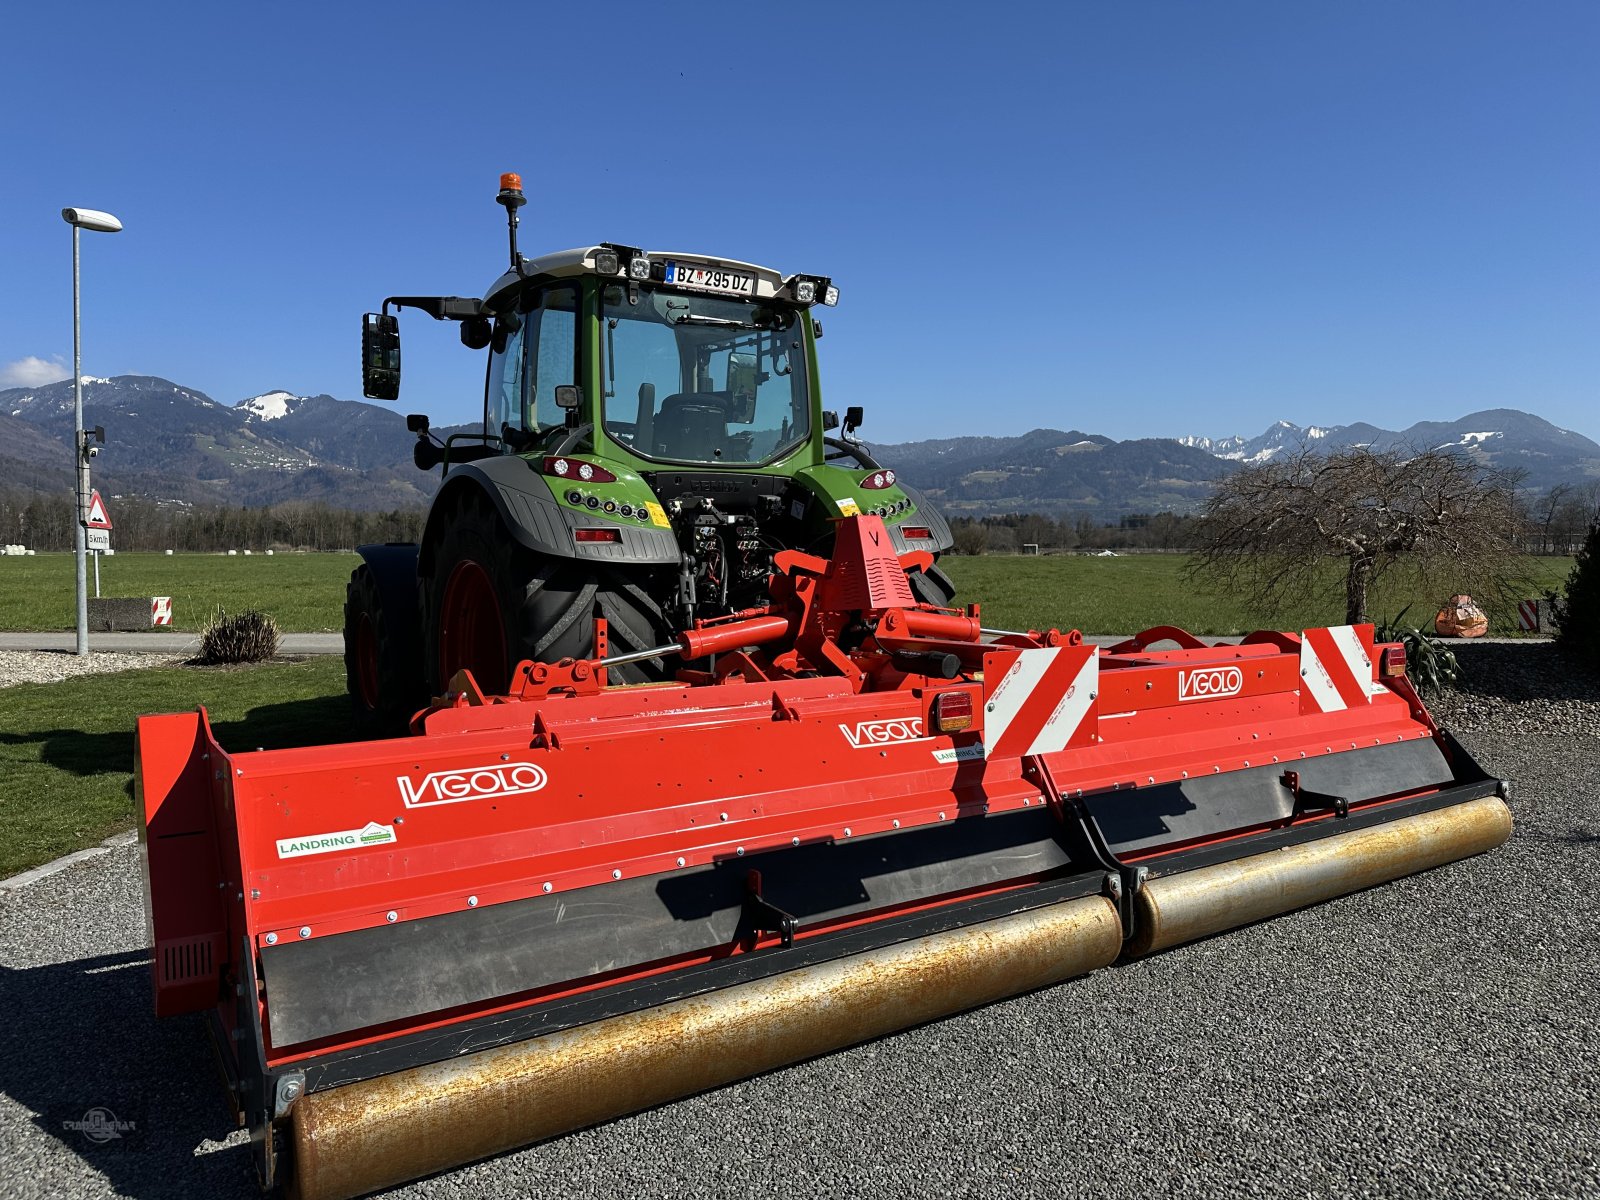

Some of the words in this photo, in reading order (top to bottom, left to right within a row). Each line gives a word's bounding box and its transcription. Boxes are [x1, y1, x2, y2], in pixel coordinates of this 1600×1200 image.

[677, 266, 695, 284] BZ
[705, 268, 731, 289] 295
[732, 274, 749, 292] DZ
[89, 534, 93, 543] 5
[1180, 667, 1242, 700] VIGOLO
[936, 750, 975, 761] LANDRING
[398, 763, 546, 807] VIGOLO
[280, 835, 356, 854] LANDRING
